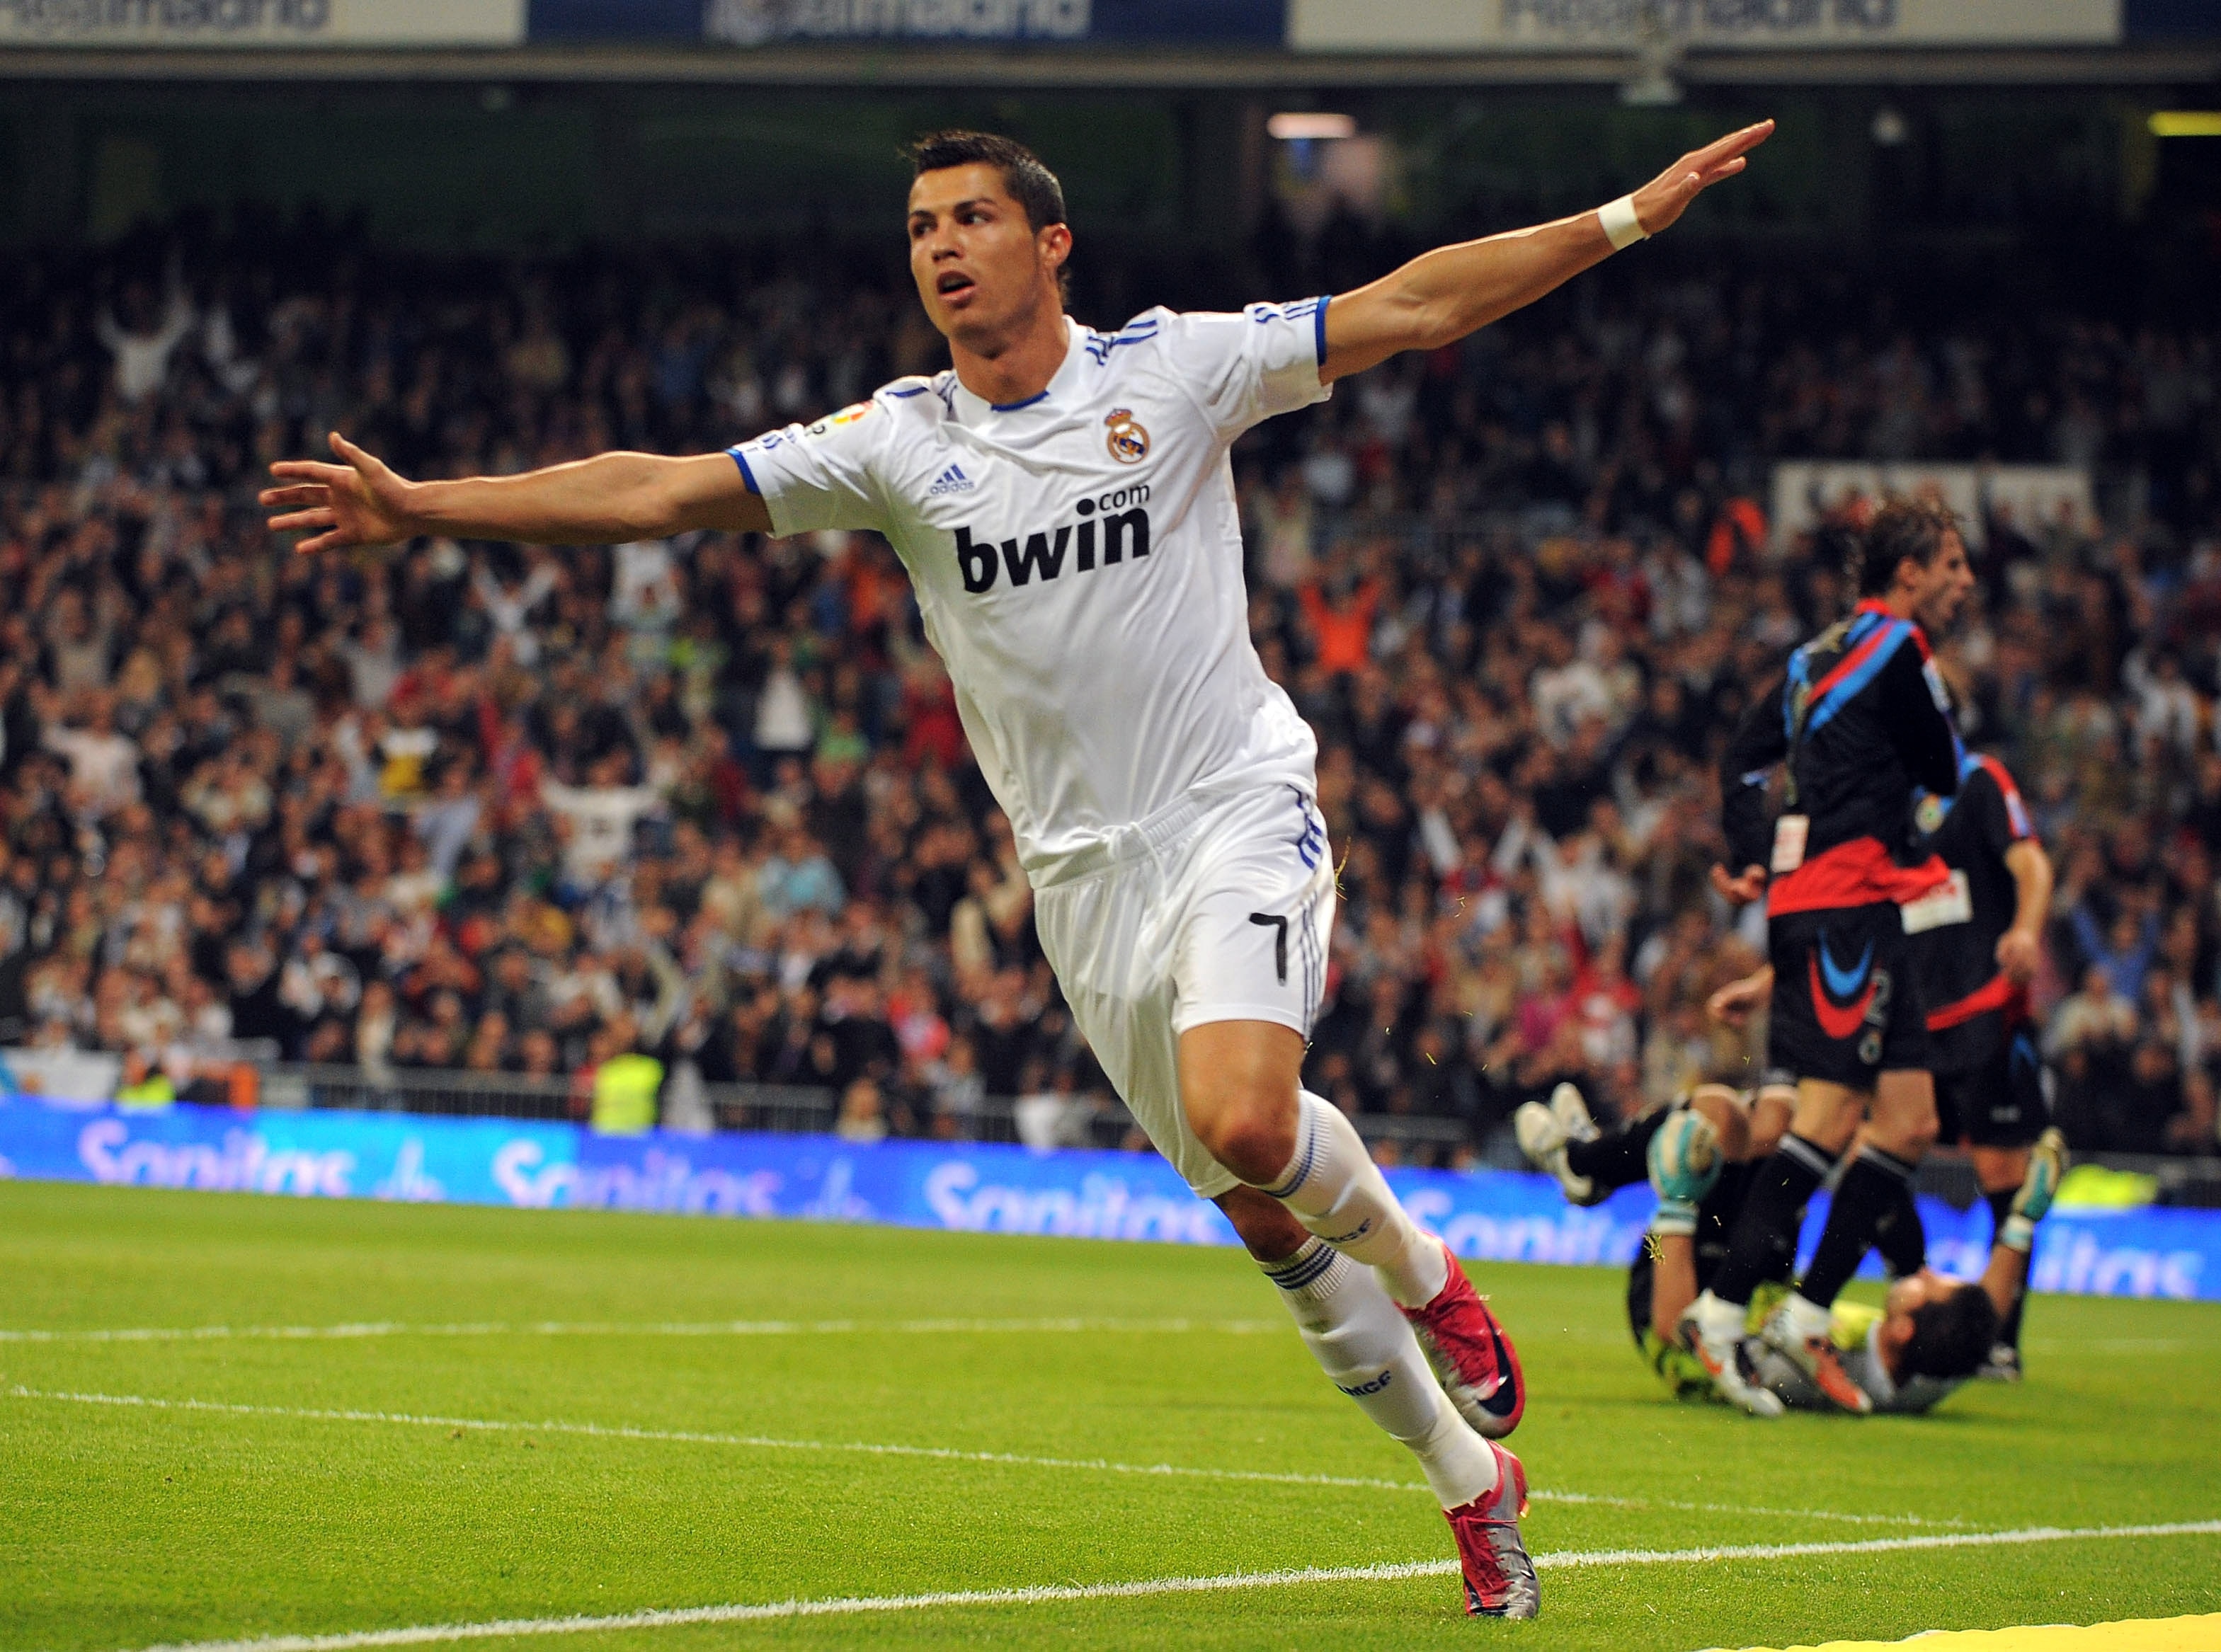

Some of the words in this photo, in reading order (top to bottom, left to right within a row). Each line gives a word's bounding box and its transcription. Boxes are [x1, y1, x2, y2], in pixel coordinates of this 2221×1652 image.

[930, 481, 975, 495] adidas
[954, 498, 1151, 594] bwin
[1248, 912, 1288, 986] 7
[79, 1118, 358, 1198] Sanitas
[491, 1139, 782, 1218] Sanitas
[926, 1161, 1223, 1244] Sanitas
